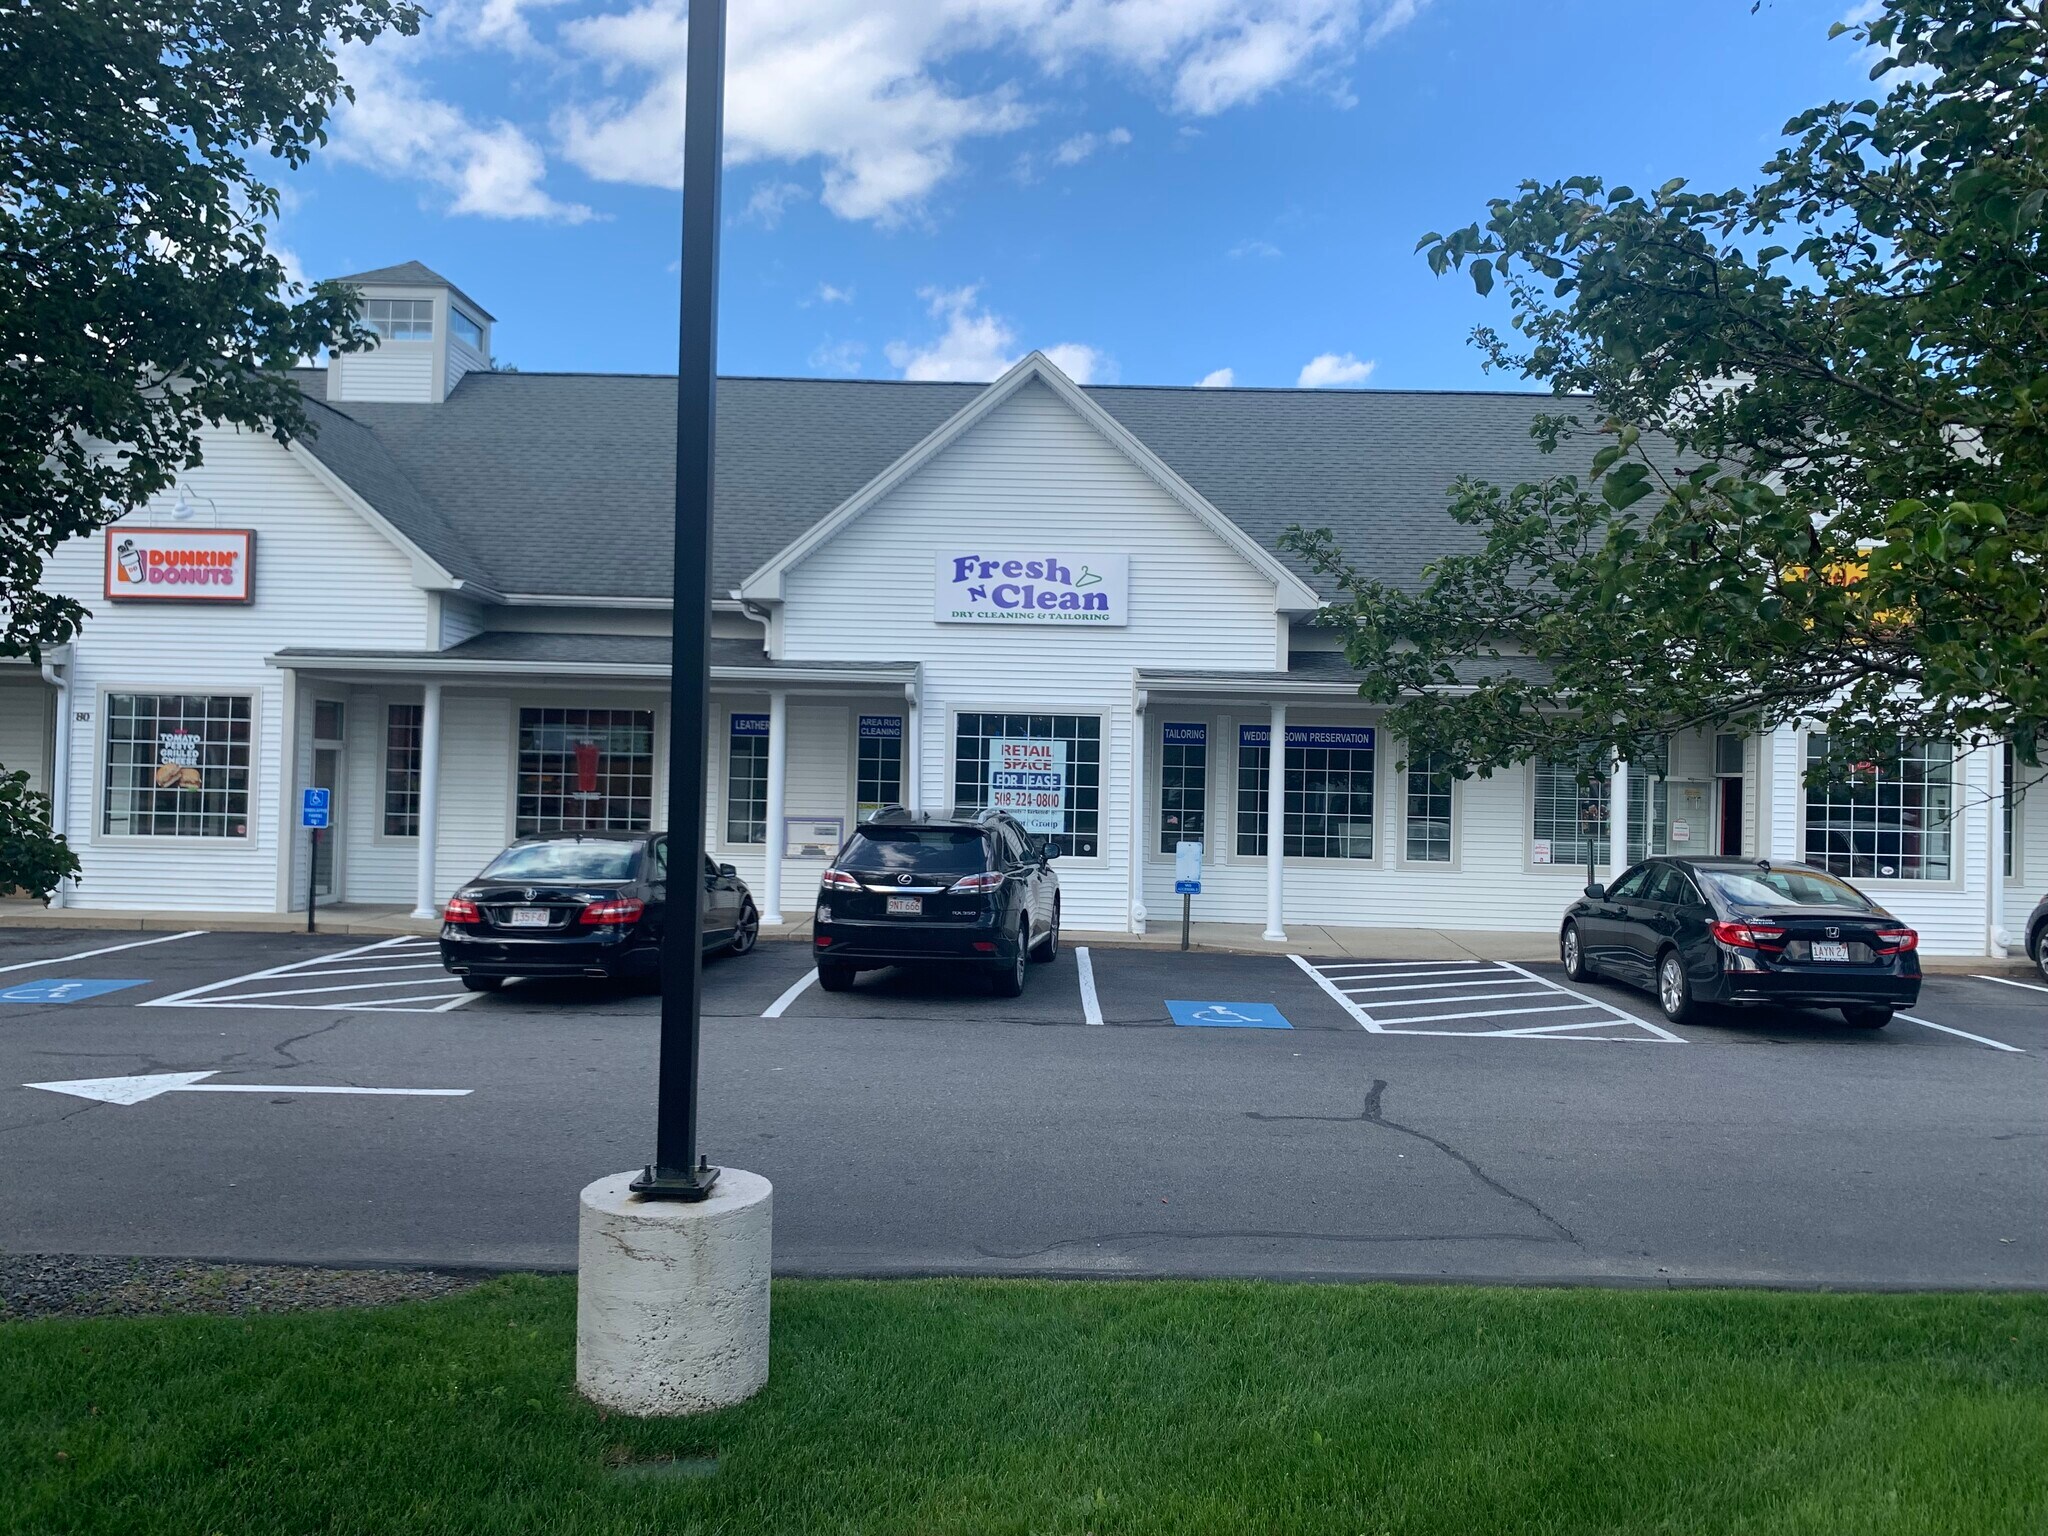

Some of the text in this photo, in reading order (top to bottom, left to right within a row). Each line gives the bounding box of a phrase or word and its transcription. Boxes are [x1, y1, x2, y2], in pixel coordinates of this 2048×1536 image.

[149, 549, 238, 567] DUNKIN'
[148, 567, 233, 585] DONUTS
[952, 555, 1072, 585] Fresh
[967, 583, 1109, 611] N Clean
[951, 610, 975, 619] DRY
[977, 611, 1035, 620] CLEANING
[1048, 613, 1110, 621] TAILORING
[860, 718, 901, 727] AREA RUG
[860, 727, 901, 736] CLEANING
[1165, 728, 1205, 740] TAILORING
[1243, 731, 1271, 741] WEDDI
[1309, 732, 1370, 744] PRESERVATION
[160, 733, 201, 743] TOMATO
[165, 741, 195, 750] PESTO
[1001, 744, 1054, 757] RETAIL
[160, 748, 199, 758] GRILLED
[161, 756, 197, 766] CHEESE
[1003, 758, 1052, 771] SPACE
[996, 774, 1058, 788] FOR LEASE
[994, 791, 1060, 808] 508-224-0800
[1031, 820, 1058, 829] Group
